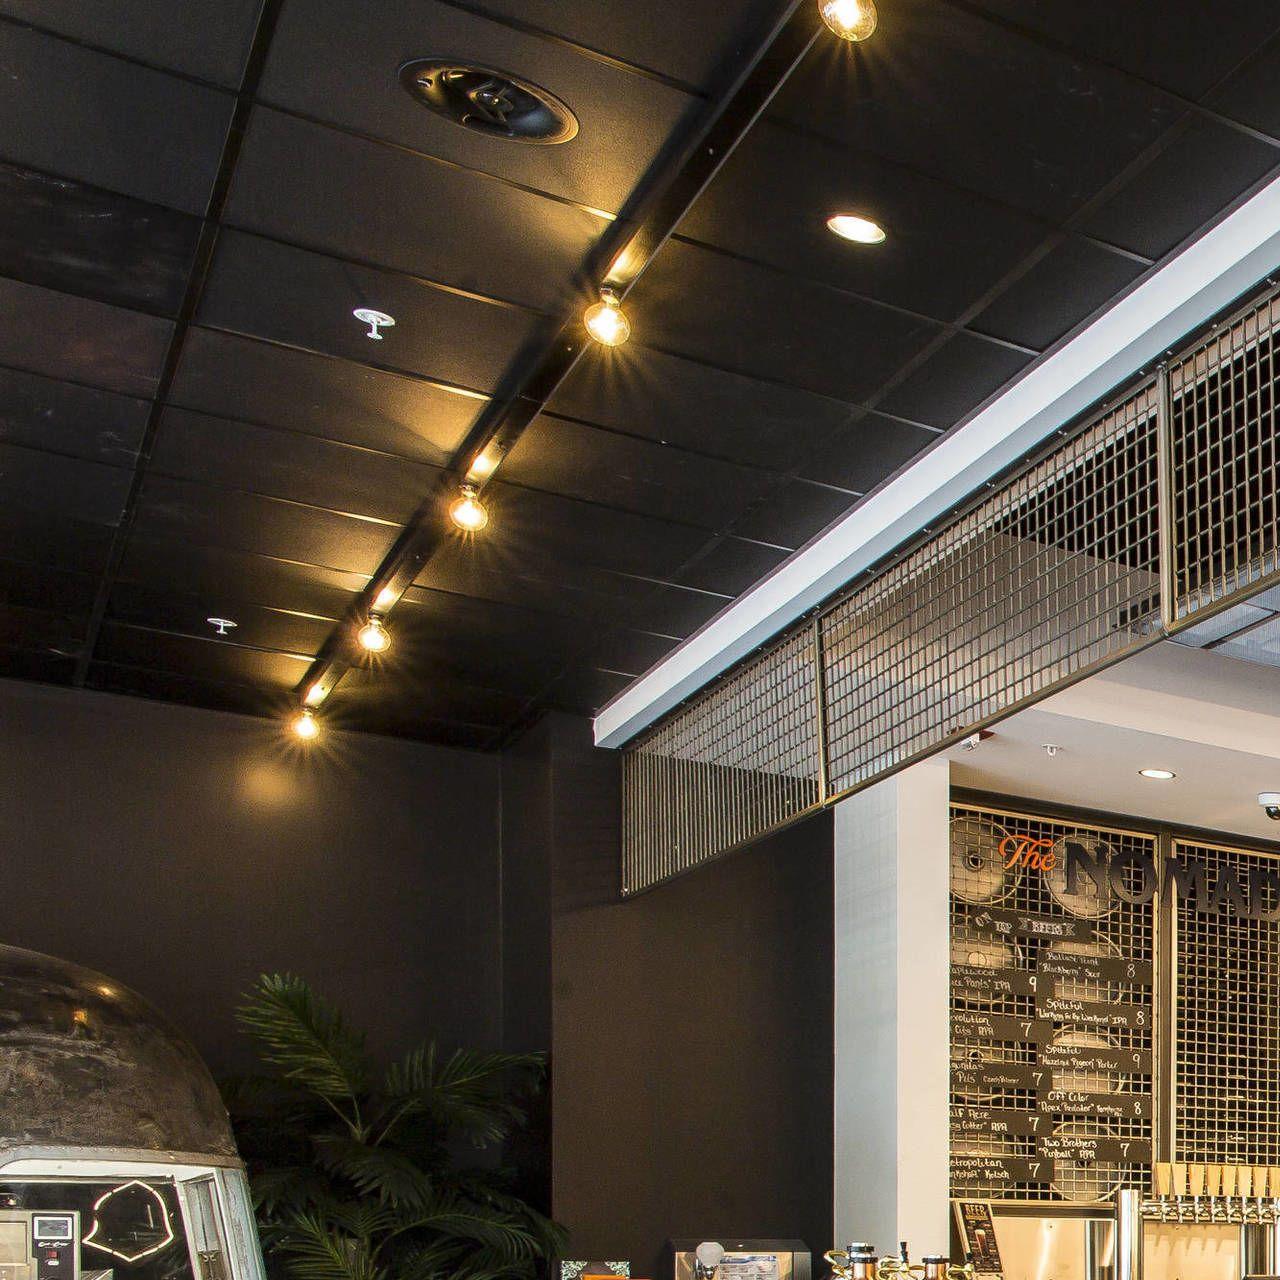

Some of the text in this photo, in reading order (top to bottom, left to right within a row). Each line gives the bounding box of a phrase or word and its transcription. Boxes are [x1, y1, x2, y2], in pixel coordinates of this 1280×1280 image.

[998, 834, 1056, 871] The
[1127, 963, 1136, 979] 8
[1028, 976, 1037, 993] 9
[1136, 1010, 1145, 1026] 8
[1020, 1022, 1032, 1037] 7
[1132, 1053, 1141, 1069] 9
[1032, 1072, 1043, 1087] 7
[1133, 1101, 1142, 1115] 8
[1028, 1117, 1040, 1132] 7
[1120, 1143, 1130, 1158] 7
[949, 1157, 1003, 1170] etropolitan
[1028, 1163, 1041, 1179] 7
[964, 1203, 985, 1217] BEER
